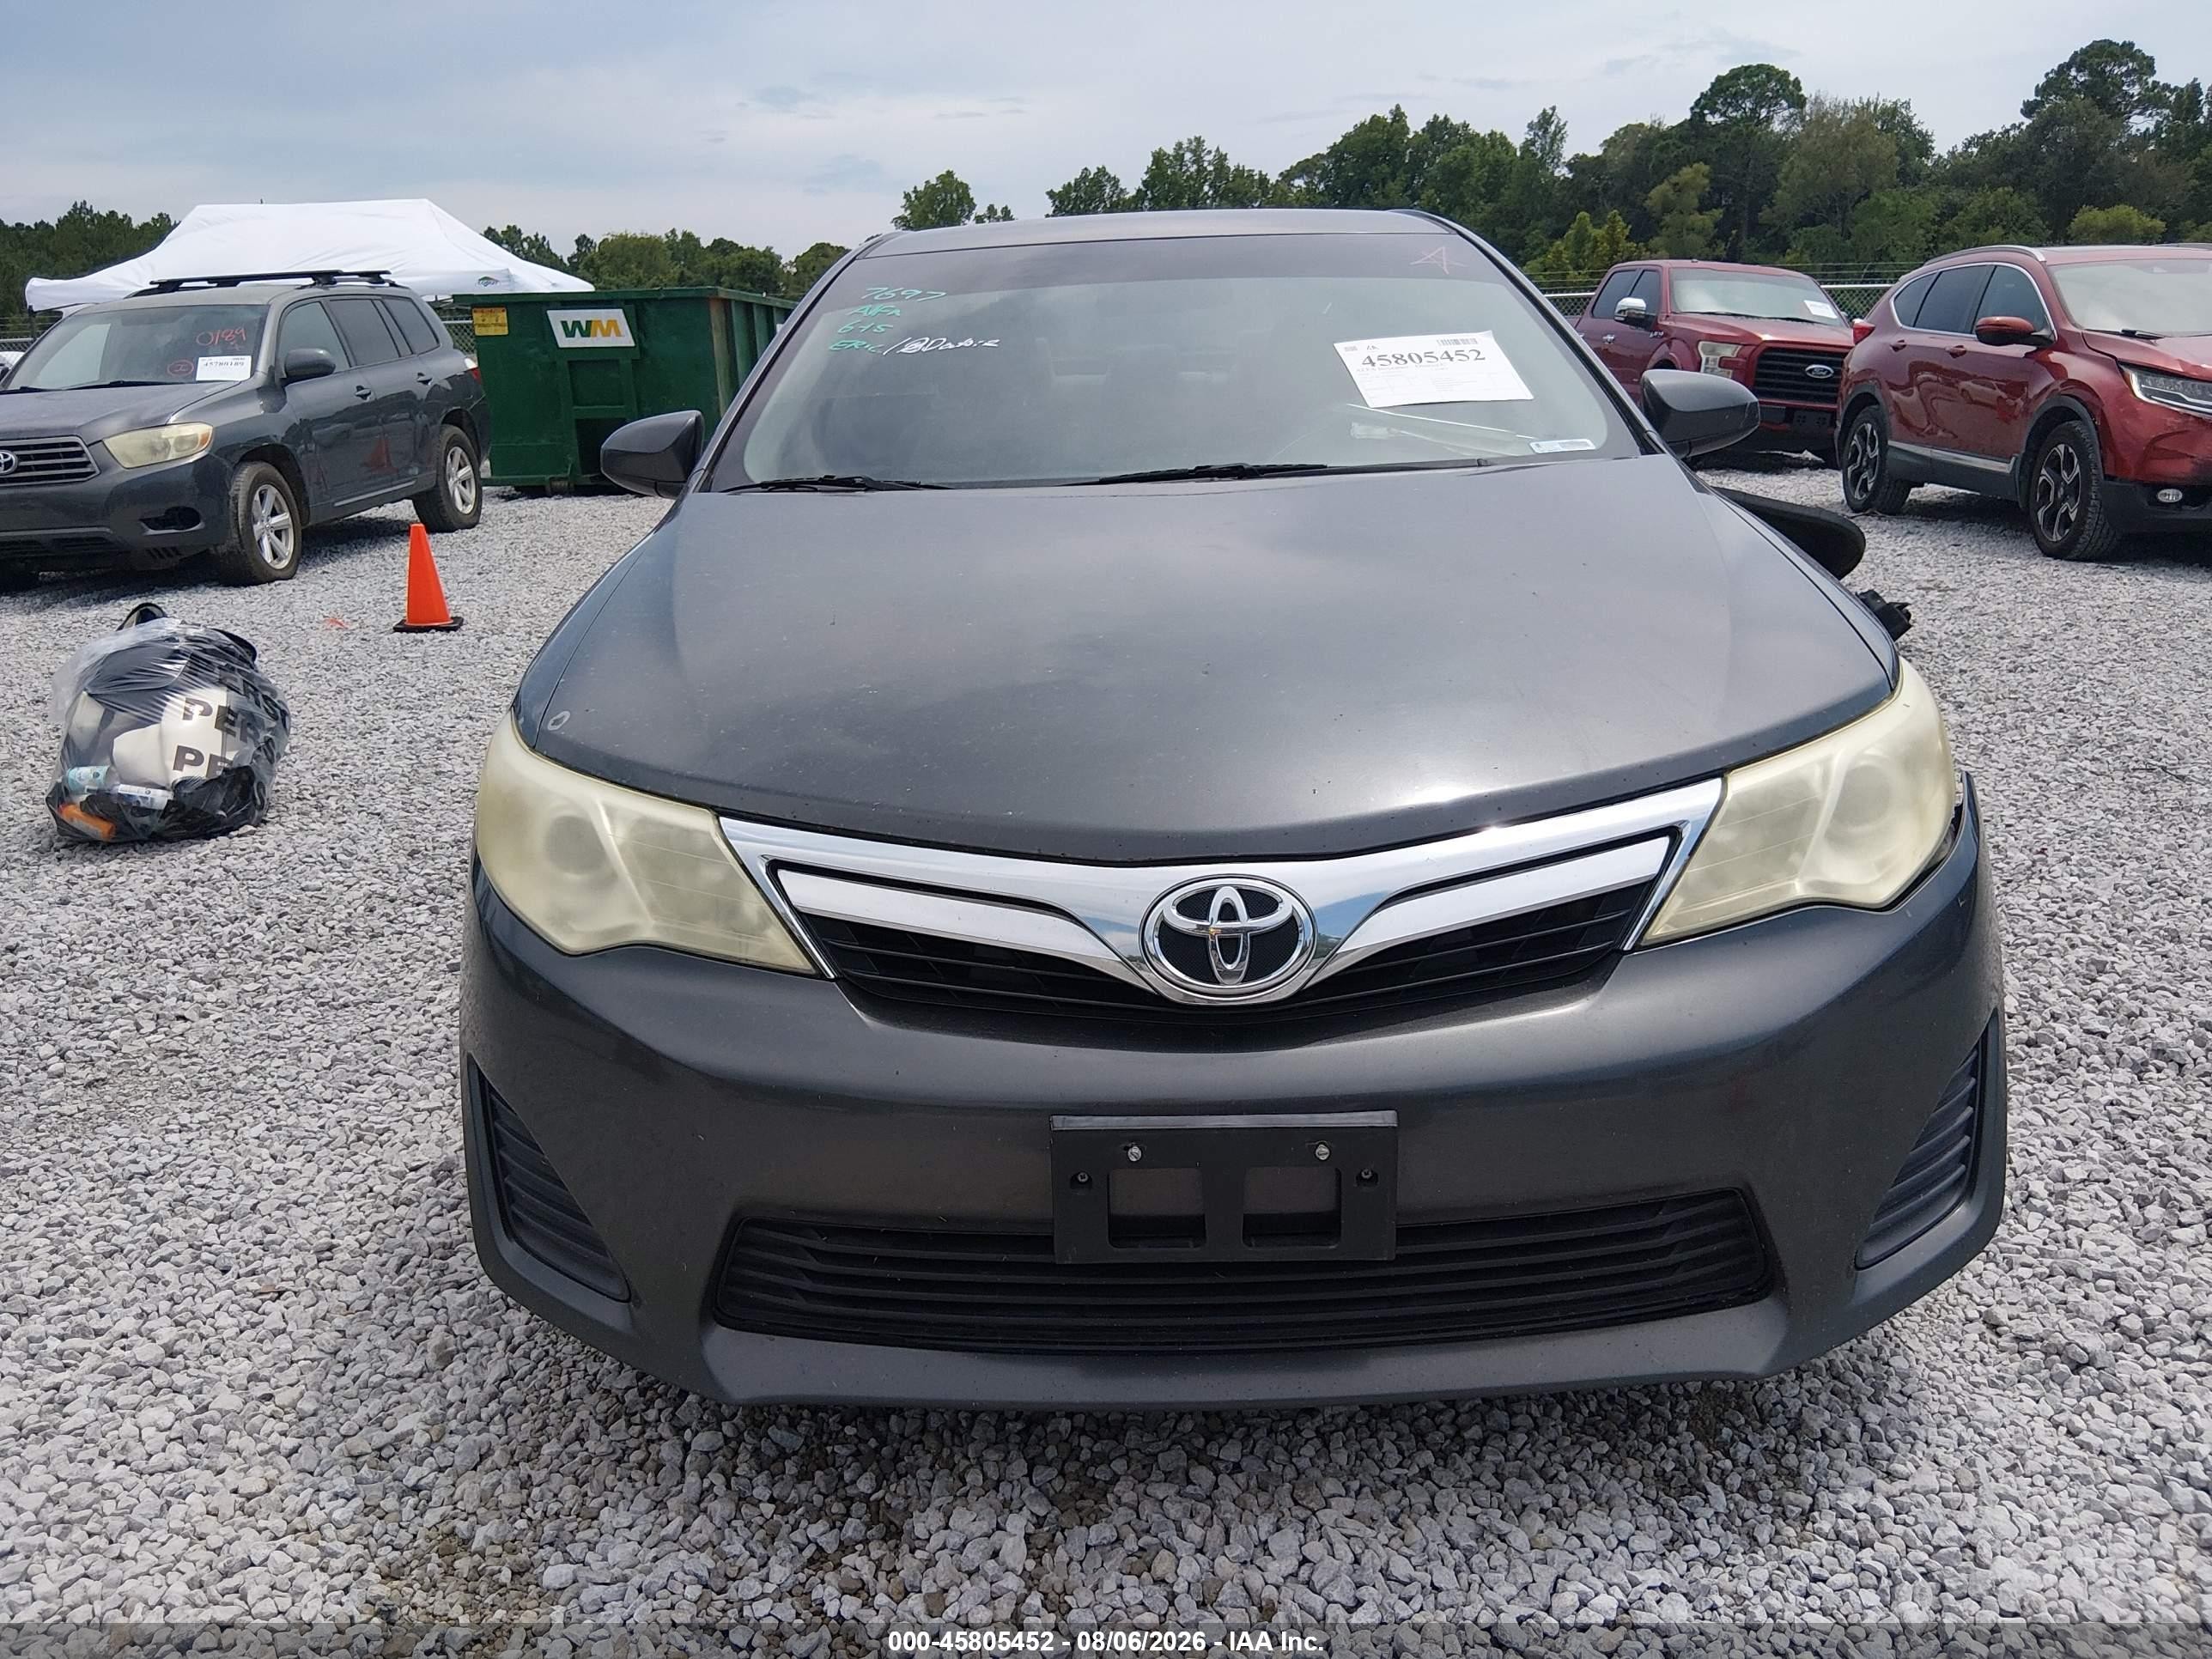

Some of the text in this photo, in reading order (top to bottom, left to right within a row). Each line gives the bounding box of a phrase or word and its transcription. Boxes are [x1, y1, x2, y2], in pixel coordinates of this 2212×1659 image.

[861, 286, 947, 301] 7697
[196, 326, 246, 346] 0189
[561, 319, 623, 337] WM
[1362, 349, 1486, 368] 45805452
